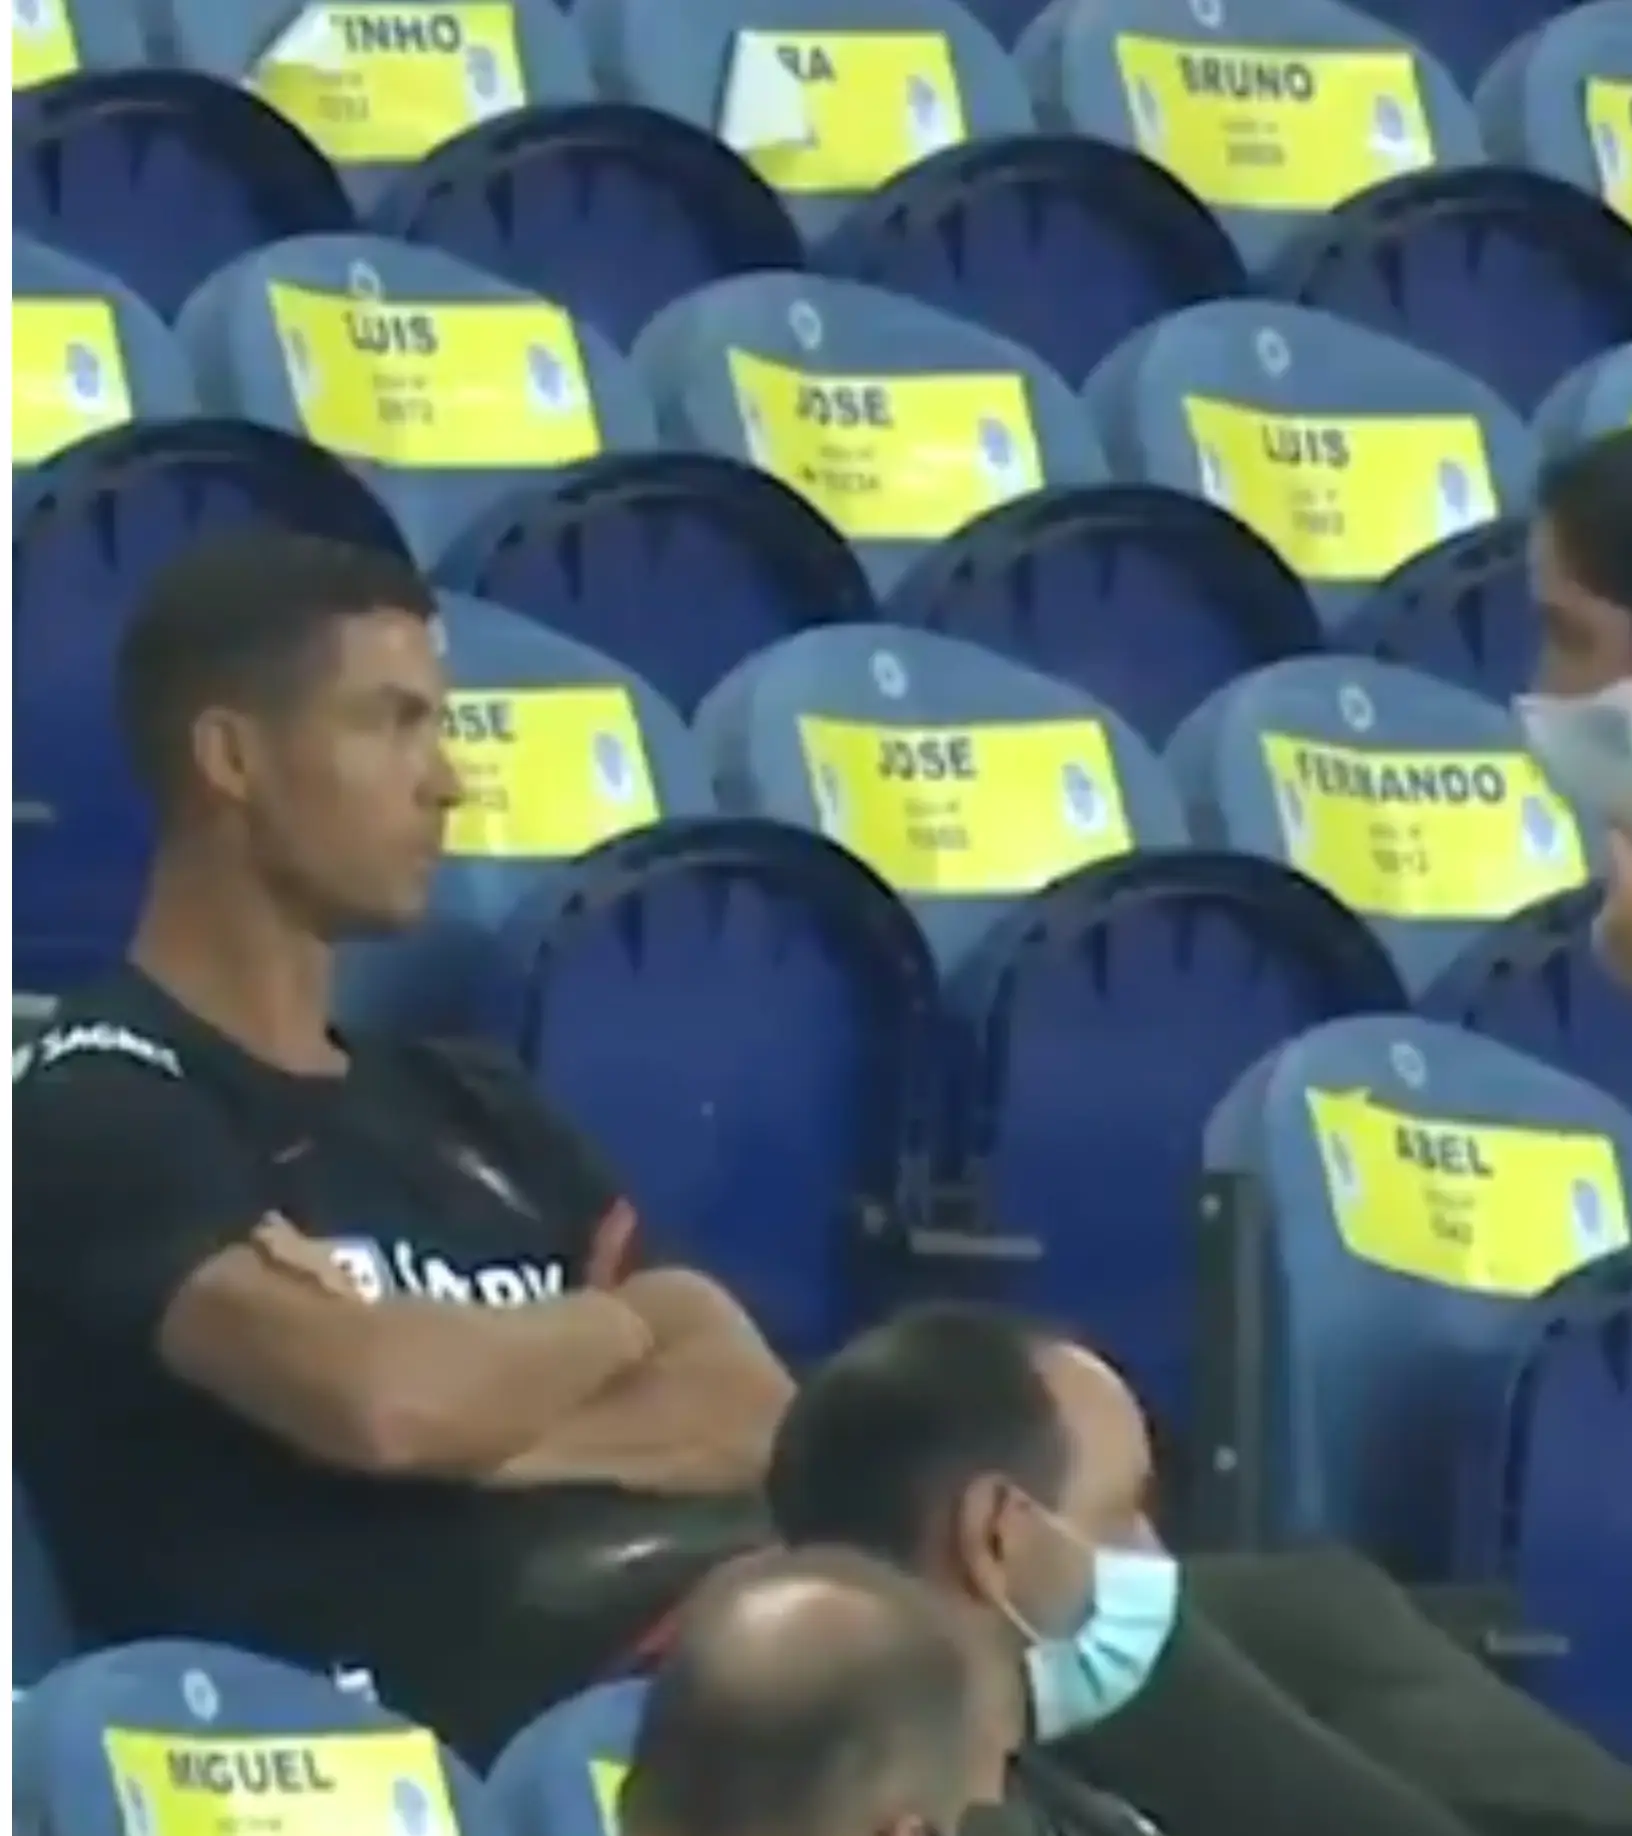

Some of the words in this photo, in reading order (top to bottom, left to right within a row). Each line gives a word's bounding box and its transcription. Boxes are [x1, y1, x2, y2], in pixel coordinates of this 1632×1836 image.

[1178, 54, 1316, 102] BRUNO
[342, 310, 439, 358] LUIS
[796, 384, 894, 429] JOSE
[1261, 423, 1350, 468] LUIS
[877, 737, 979, 782] JOSE
[1295, 750, 1507, 805] FERNANDO
[1395, 1123, 1496, 1180] ABEL
[165, 1748, 337, 1796] MIGUEL
